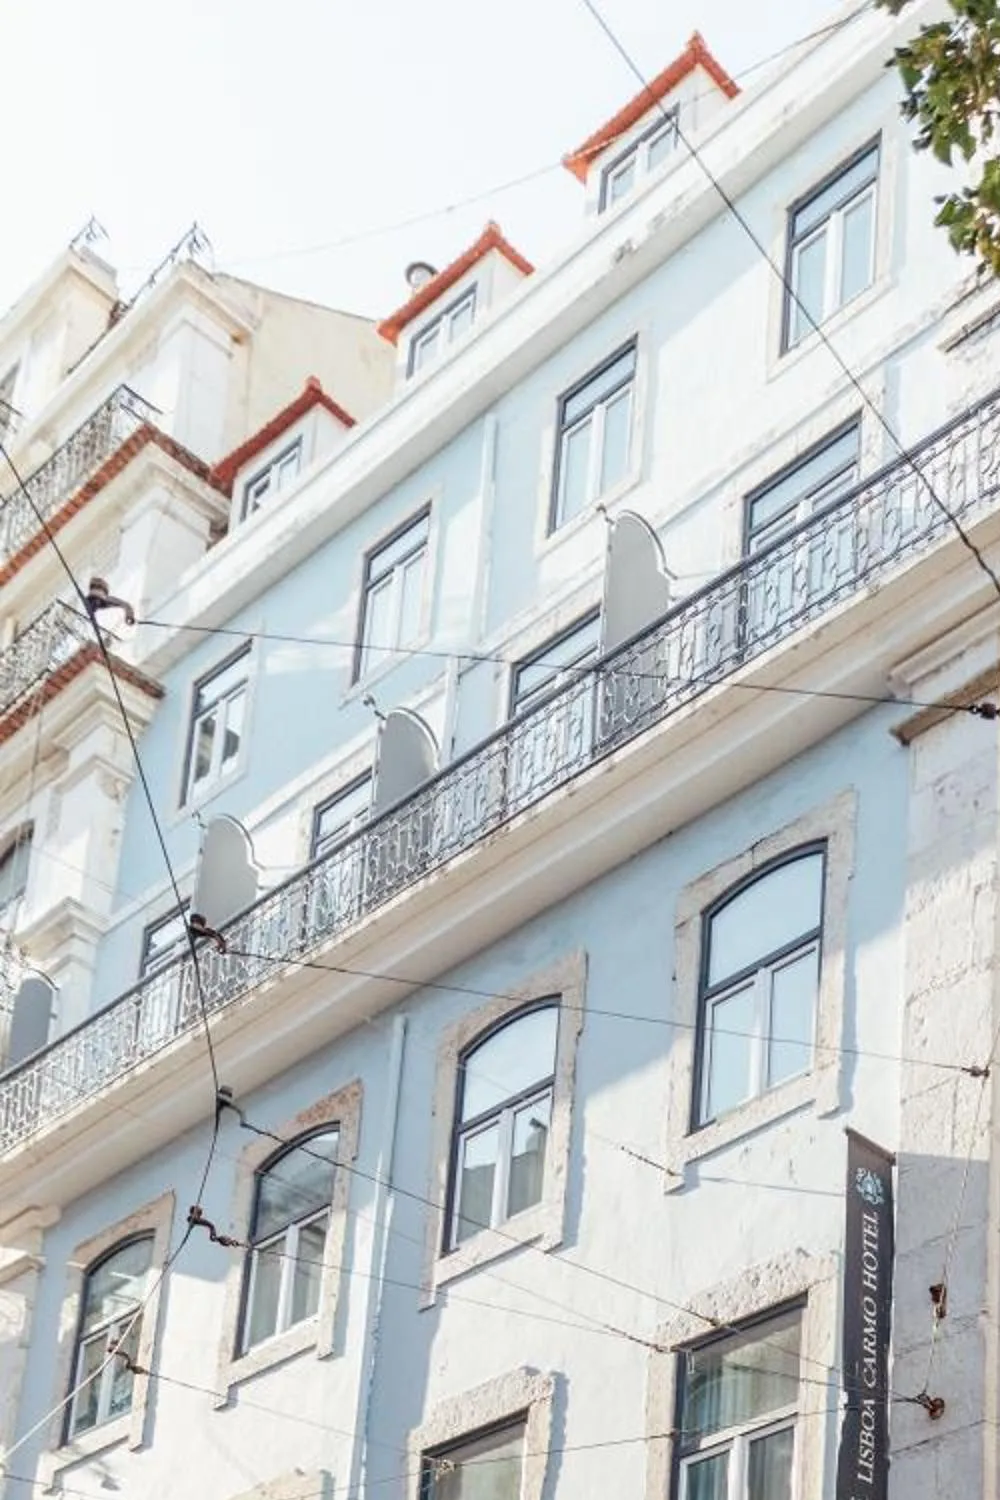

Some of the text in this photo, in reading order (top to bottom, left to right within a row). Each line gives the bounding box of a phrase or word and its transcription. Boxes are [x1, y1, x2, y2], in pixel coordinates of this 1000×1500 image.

[857, 1211, 879, 1485] LISBOA CARMO HOTEL
